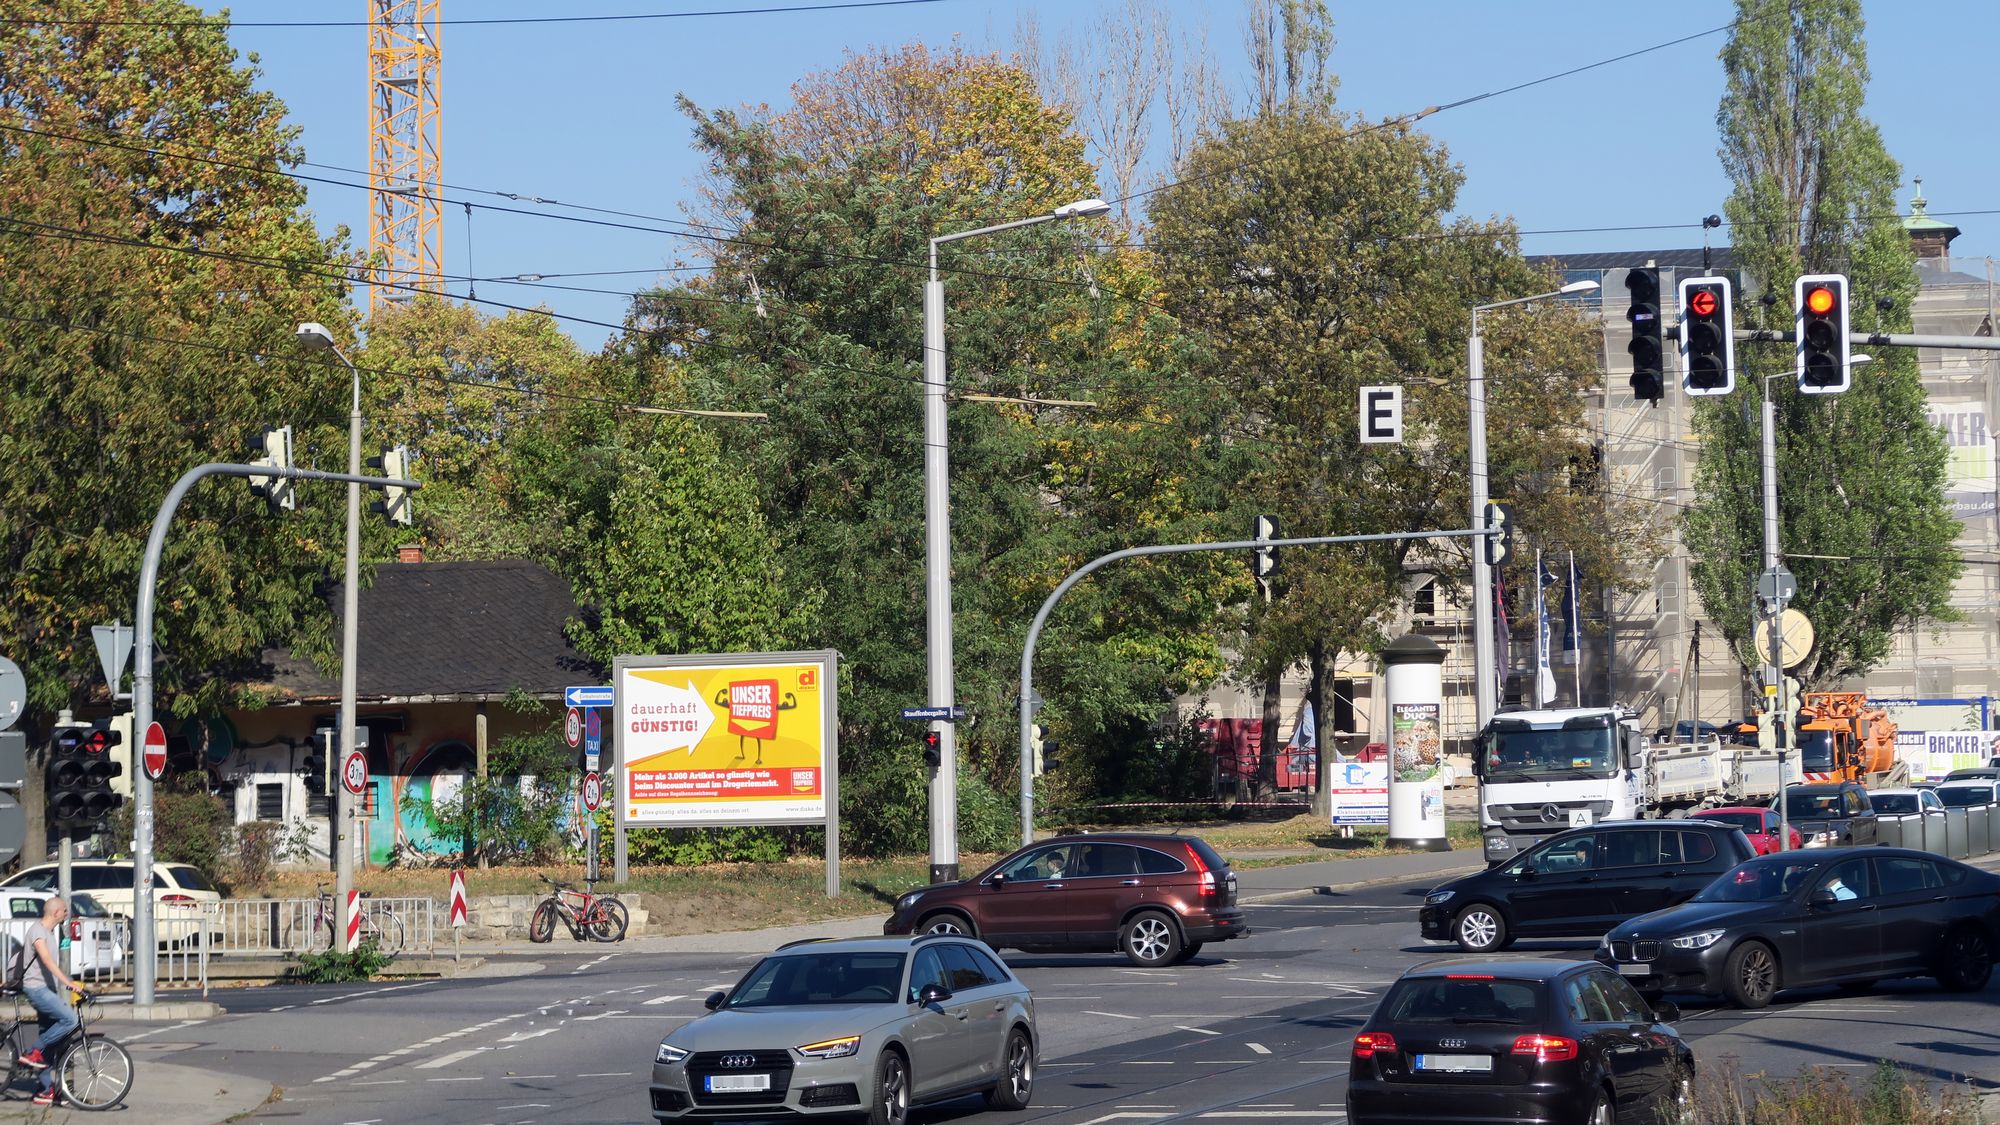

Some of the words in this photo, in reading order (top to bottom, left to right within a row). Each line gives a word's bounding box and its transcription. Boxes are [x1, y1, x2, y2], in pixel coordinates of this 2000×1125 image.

[1368, 392, 1394, 437] E
[799, 670, 814, 685] d
[731, 685, 772, 704] UNSER
[631, 702, 697, 715] dauerhaft
[732, 704, 772, 718] TIEFPREIS
[1396, 705, 1437, 713] ELEGANTES
[1403, 712, 1426, 720] DUO
[631, 718, 698, 733] GÜNSTIG!
[587, 740, 599, 751] TAXI
[1929, 736, 1979, 754] BACKER
[634, 773, 654, 781] Mehr
[667, 772, 688, 780] 3.000
[689, 771, 715, 780] Artikel
[727, 770, 755, 780] günstig
[756, 770, 770, 778] wie
[792, 771, 813, 779] UNSER
[634, 782, 654, 790] beim
[654, 781, 695, 790] Discounter
[695, 780, 710, 789] und
[722, 779, 779, 789] Drogeriemarkt.
[1575, 813, 1588, 825] A
